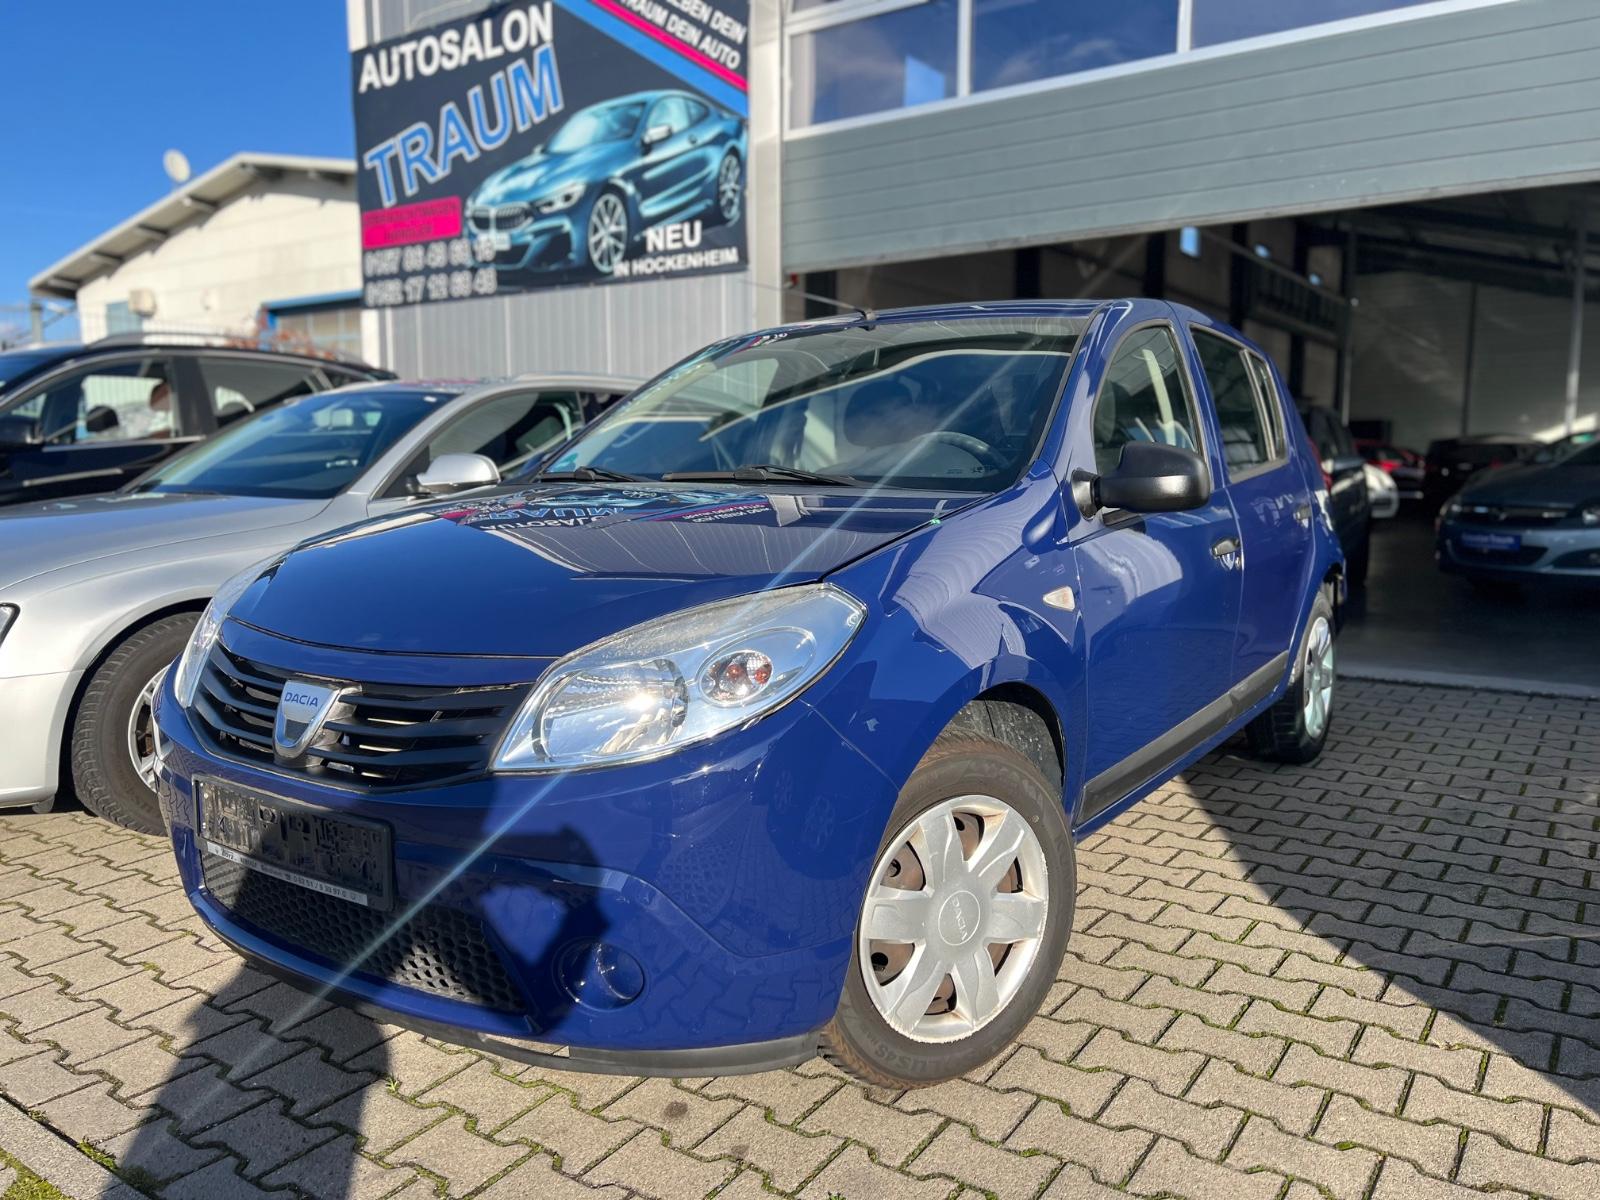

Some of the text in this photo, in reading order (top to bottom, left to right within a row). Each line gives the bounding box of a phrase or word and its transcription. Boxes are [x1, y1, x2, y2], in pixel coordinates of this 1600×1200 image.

[619, 0, 740, 69] RAUM DEIN AUTO
[710, 10, 747, 44] DEIN
[359, 2, 552, 93] AUTOSALON
[363, 42, 564, 208] TRAUM
[645, 219, 702, 253] NEU
[632, 246, 738, 275] HOCKENHEIM
[284, 691, 318, 707] DACIA
[951, 896, 968, 941] DACIA
